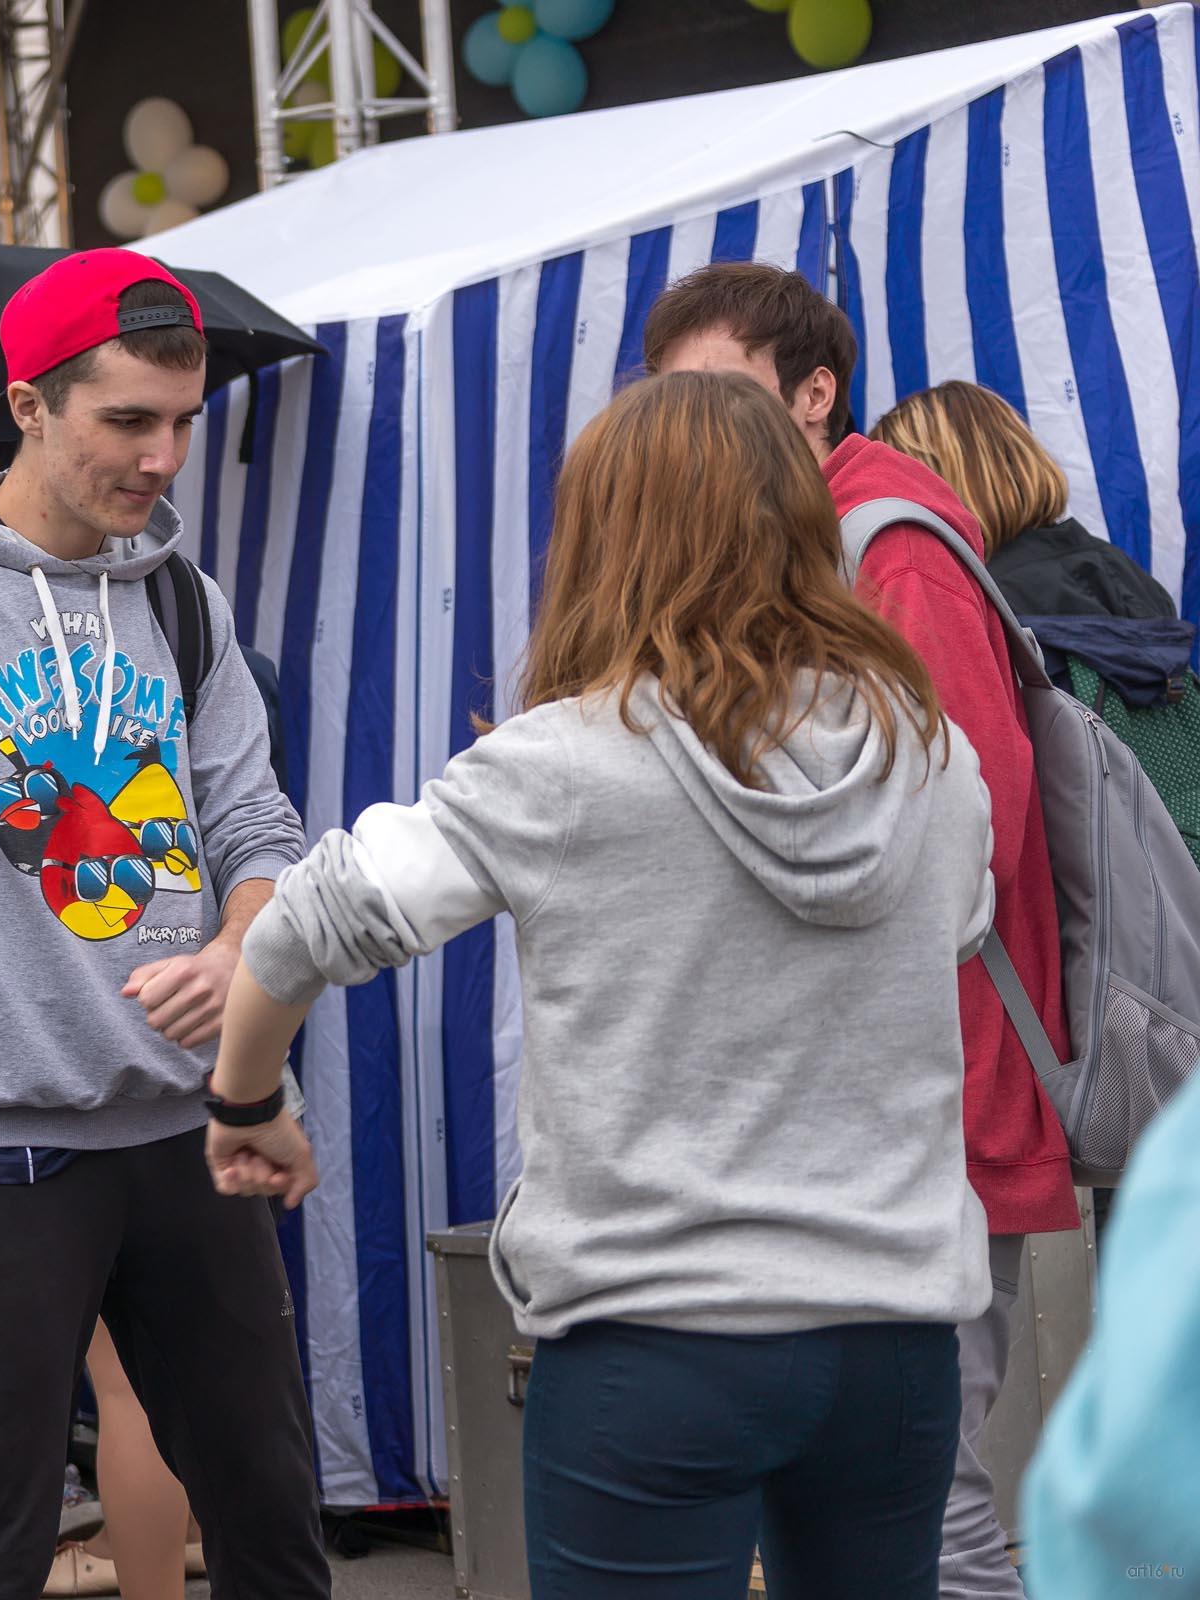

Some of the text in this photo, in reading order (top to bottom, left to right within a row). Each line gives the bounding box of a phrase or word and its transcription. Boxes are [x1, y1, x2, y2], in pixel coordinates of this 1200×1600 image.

[1172, 112, 1184, 136] YES
[1003, 143, 1011, 167] YES
[577, 320, 588, 345] YES
[1064, 379, 1075, 403] YES
[442, 587, 452, 614] YES
[29, 611, 107, 642] WHA
[109, 714, 158, 748] IKE
[137, 924, 177, 945] ANGRY
[436, 1118, 444, 1143] YES
[352, 1394, 364, 1421] YES
